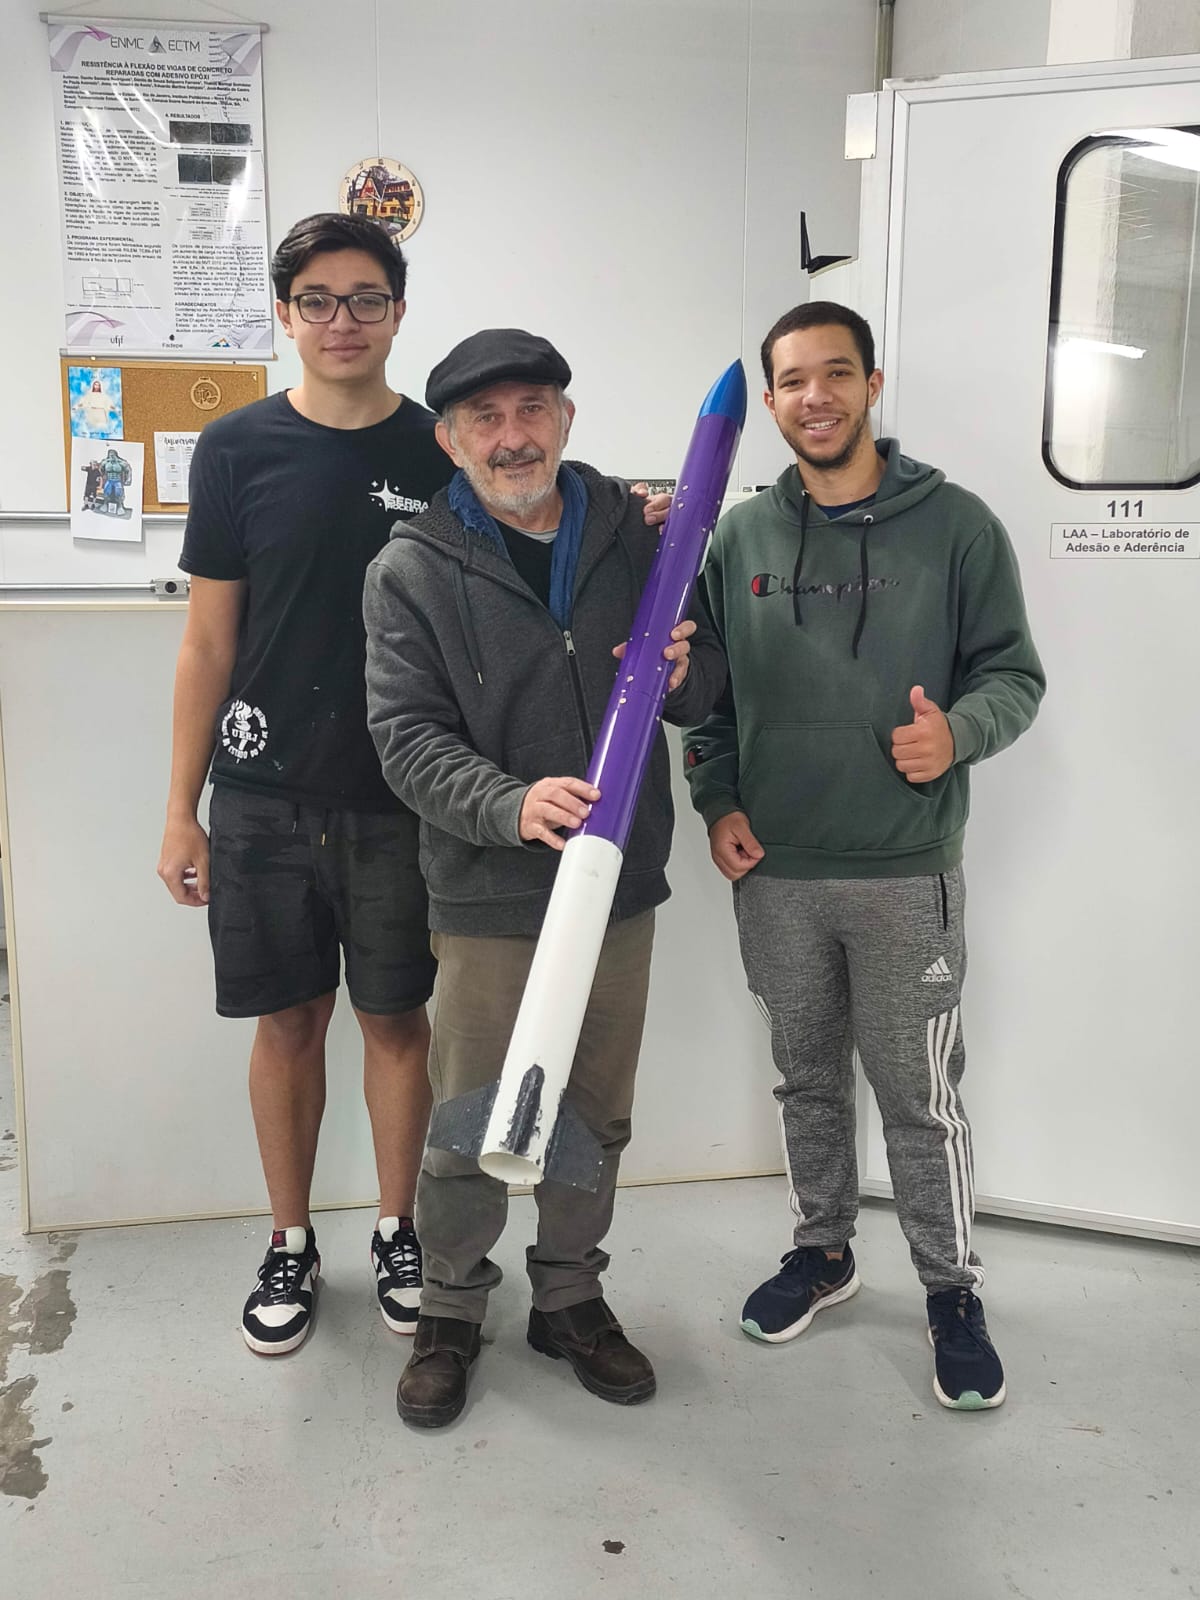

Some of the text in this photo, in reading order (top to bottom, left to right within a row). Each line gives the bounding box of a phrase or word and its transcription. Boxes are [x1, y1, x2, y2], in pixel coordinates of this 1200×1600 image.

[110, 36, 200, 52] ENMC ECTM
[81, 60, 122, 68] RESISTÊNCIA
[106, 69, 144, 77] REPARADAS
[388, 497, 428, 510] SERRA
[1107, 500, 1143, 517] 111
[1063, 529, 1088, 538] LAA
[1102, 529, 1171, 538] Laboratório
[1175, 529, 1190, 538] de
[1066, 543, 1110, 552] Adesão
[1124, 542, 1184, 552] Aderência
[232, 728, 258, 742] UERJ
[921, 973, 952, 982] adidas
